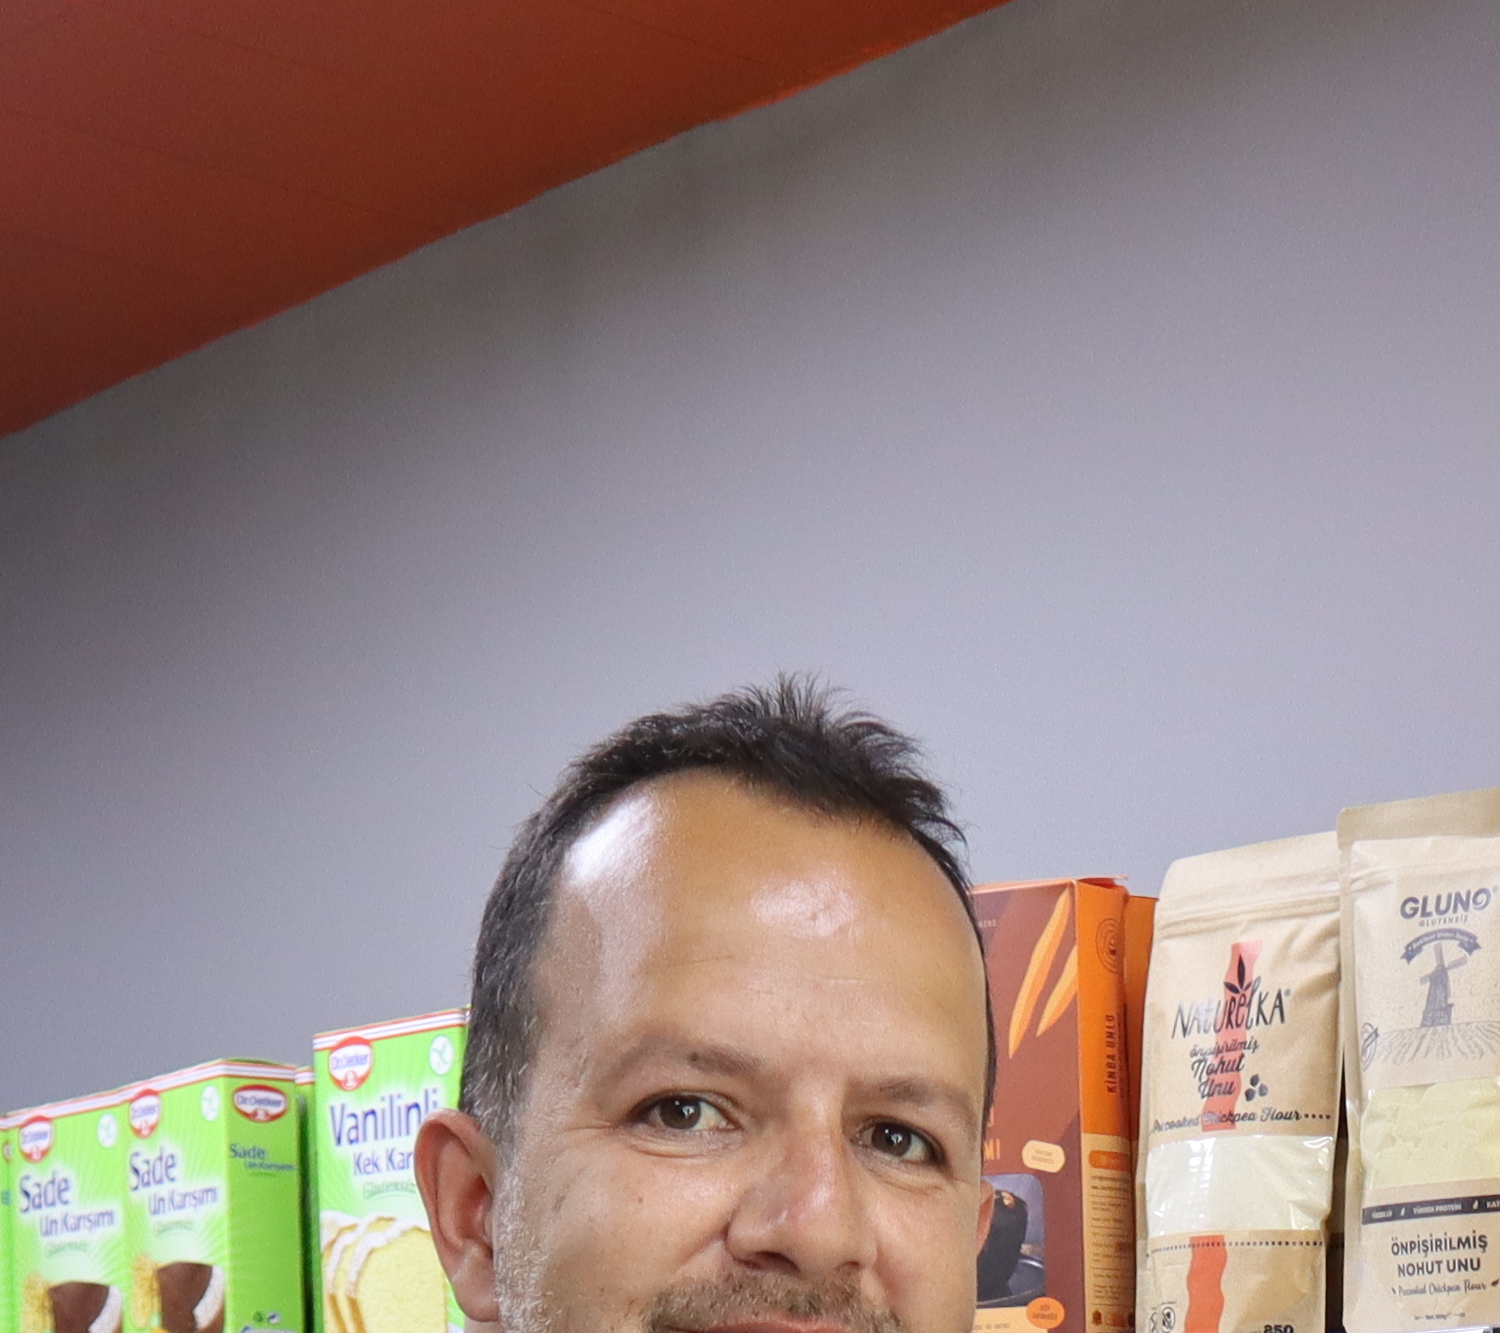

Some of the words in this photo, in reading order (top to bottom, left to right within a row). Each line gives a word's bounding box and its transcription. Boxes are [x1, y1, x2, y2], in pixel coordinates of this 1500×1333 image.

[1400, 887, 1491, 919] GLUNO
[1191, 1053, 1244, 1078] Nohut
[1198, 1080, 1236, 1099] Unu
[1261, 1108, 1302, 1123] Flour
[130, 1146, 176, 1191] Sade
[354, 1152, 380, 1176] Kek
[19, 1170, 70, 1214] Sade
[150, 1192, 166, 1216] Un
[40, 1214, 58, 1237] Un
[1391, 1229, 1488, 1257] ÖNPİŞİRİLMİŞ
[1397, 1261, 1442, 1278] NOHUT
[1446, 1257, 1482, 1274] UNU
